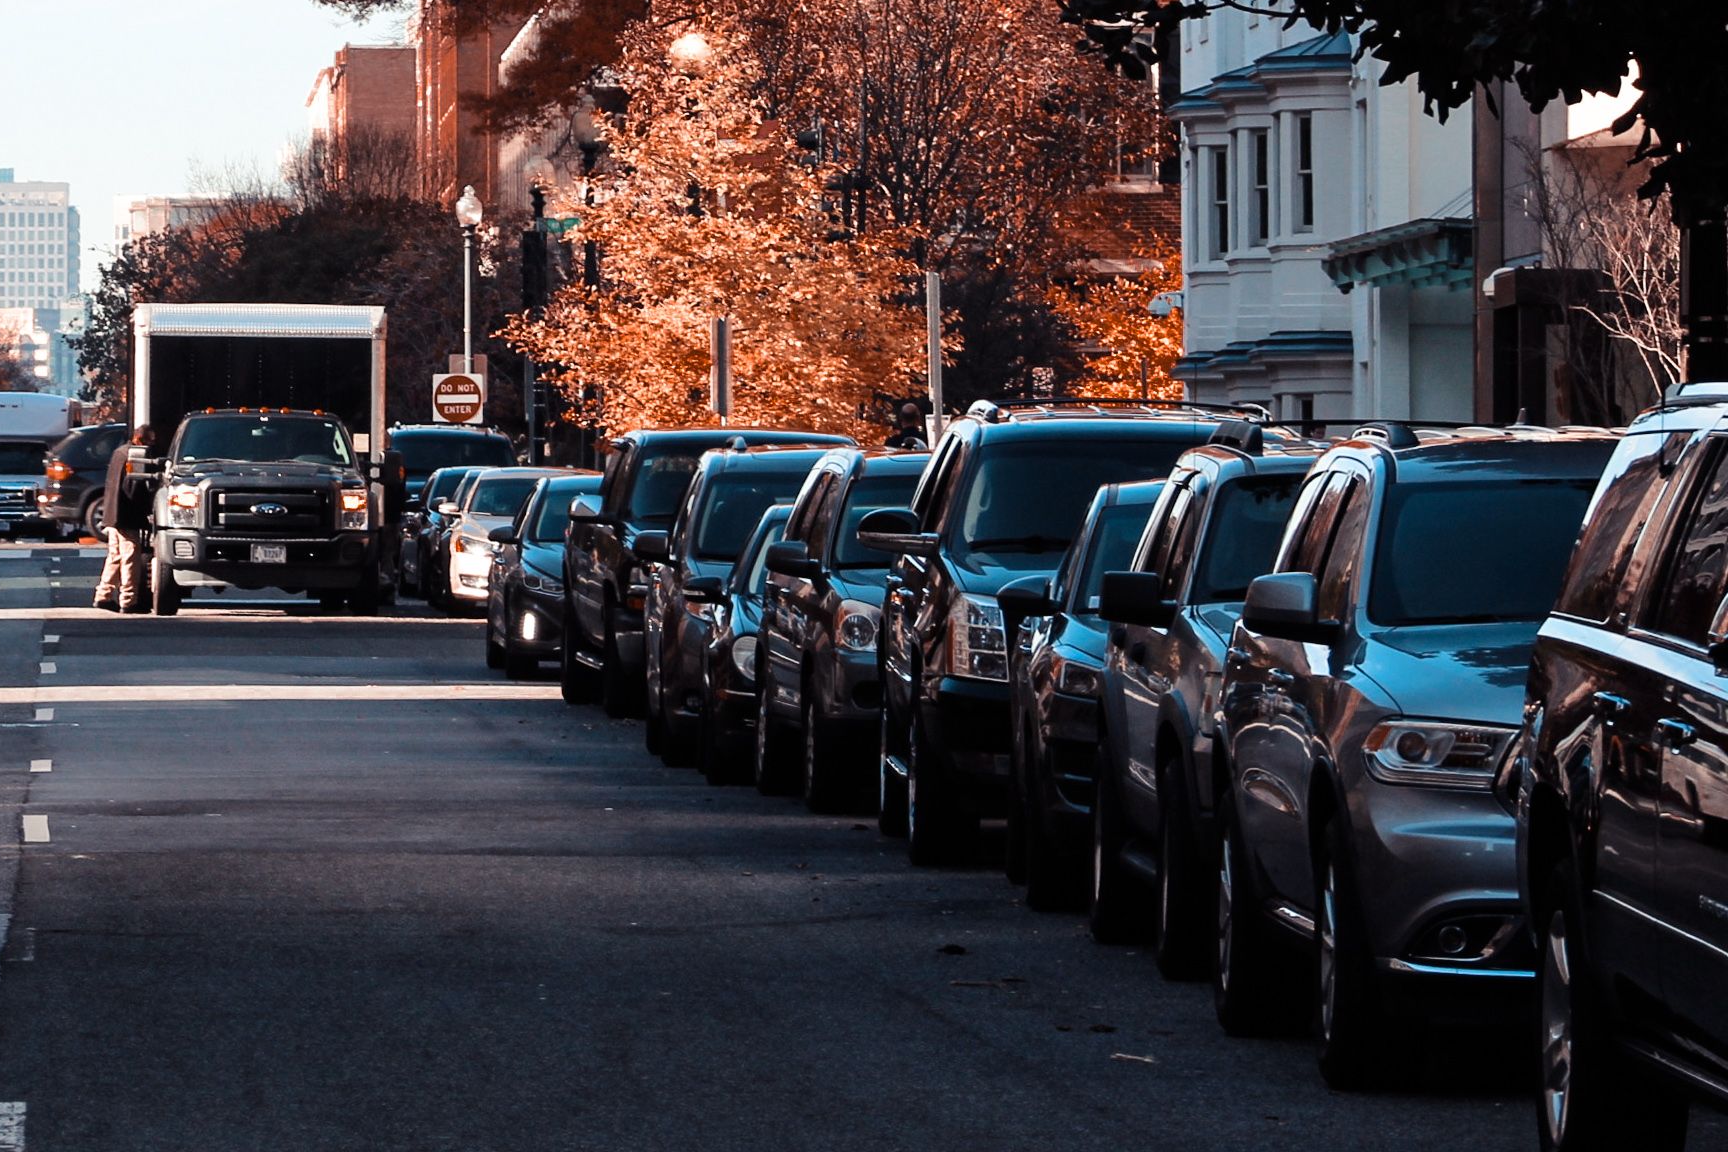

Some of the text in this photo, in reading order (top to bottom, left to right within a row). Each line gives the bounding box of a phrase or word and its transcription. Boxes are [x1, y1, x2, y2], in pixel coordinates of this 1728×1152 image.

[440, 384, 475, 392] DO NOT
[444, 405, 472, 414] ENTER
